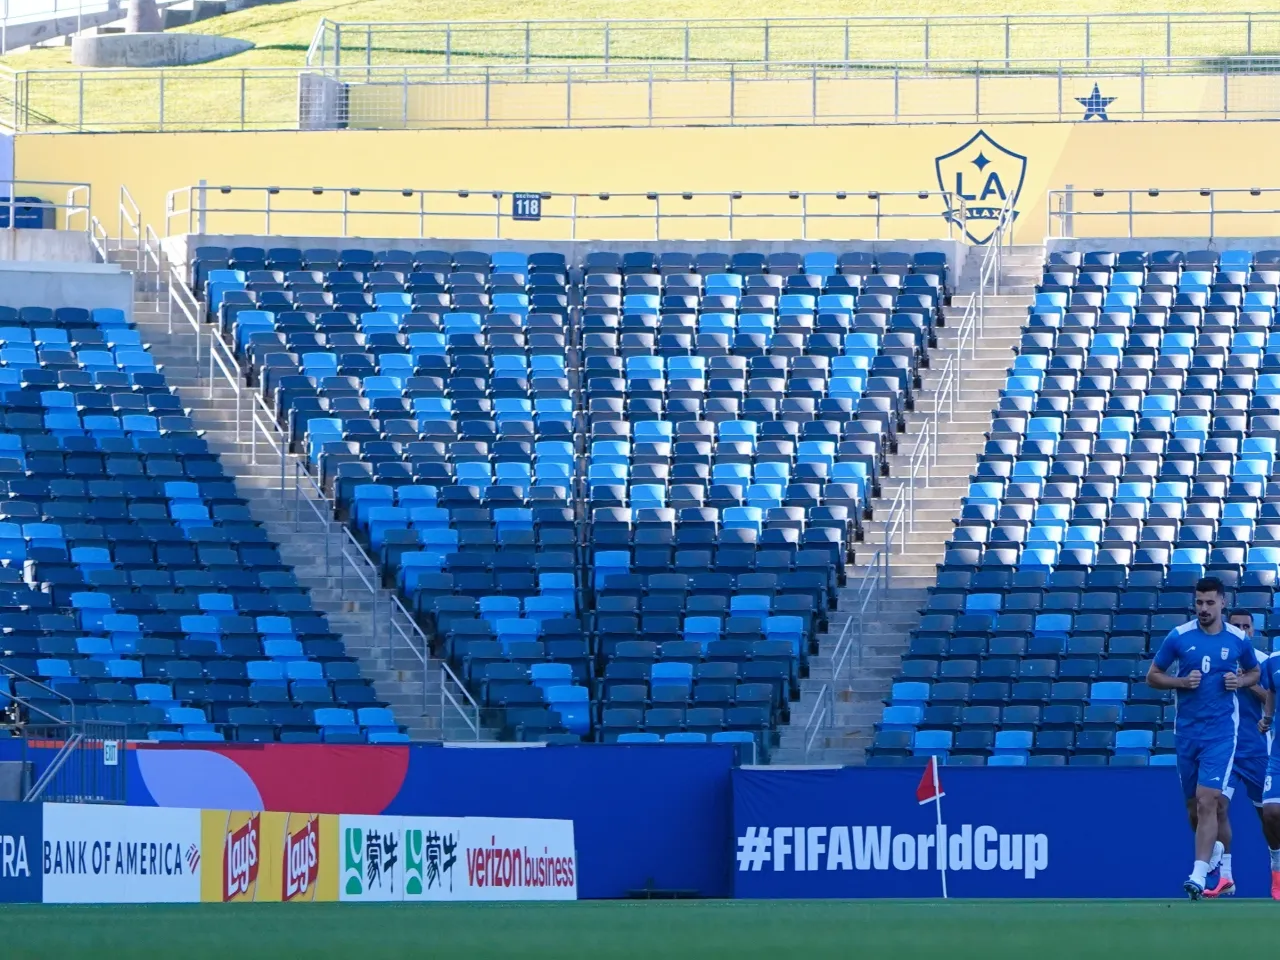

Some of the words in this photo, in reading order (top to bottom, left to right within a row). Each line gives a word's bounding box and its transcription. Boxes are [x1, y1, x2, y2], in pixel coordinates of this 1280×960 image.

[516, 199, 539, 215] 118
[956, 171, 1007, 201] LA
[1201, 655, 1211, 674] 6
[105, 744, 117, 762] EXIT
[0, 834, 29, 878] RA
[43, 840, 87, 875] BANK
[92, 840, 112, 875] OF
[115, 841, 183, 876] AMERICA
[227, 819, 257, 897] Lay's
[286, 821, 316, 897] Lay's
[366, 828, 399, 894] 蒙牛
[425, 830, 458, 894] 蒙牛
[466, 835, 522, 888] verizon
[524, 845, 574, 887] business
[737, 824, 1048, 879] #FIFAWorldCup
